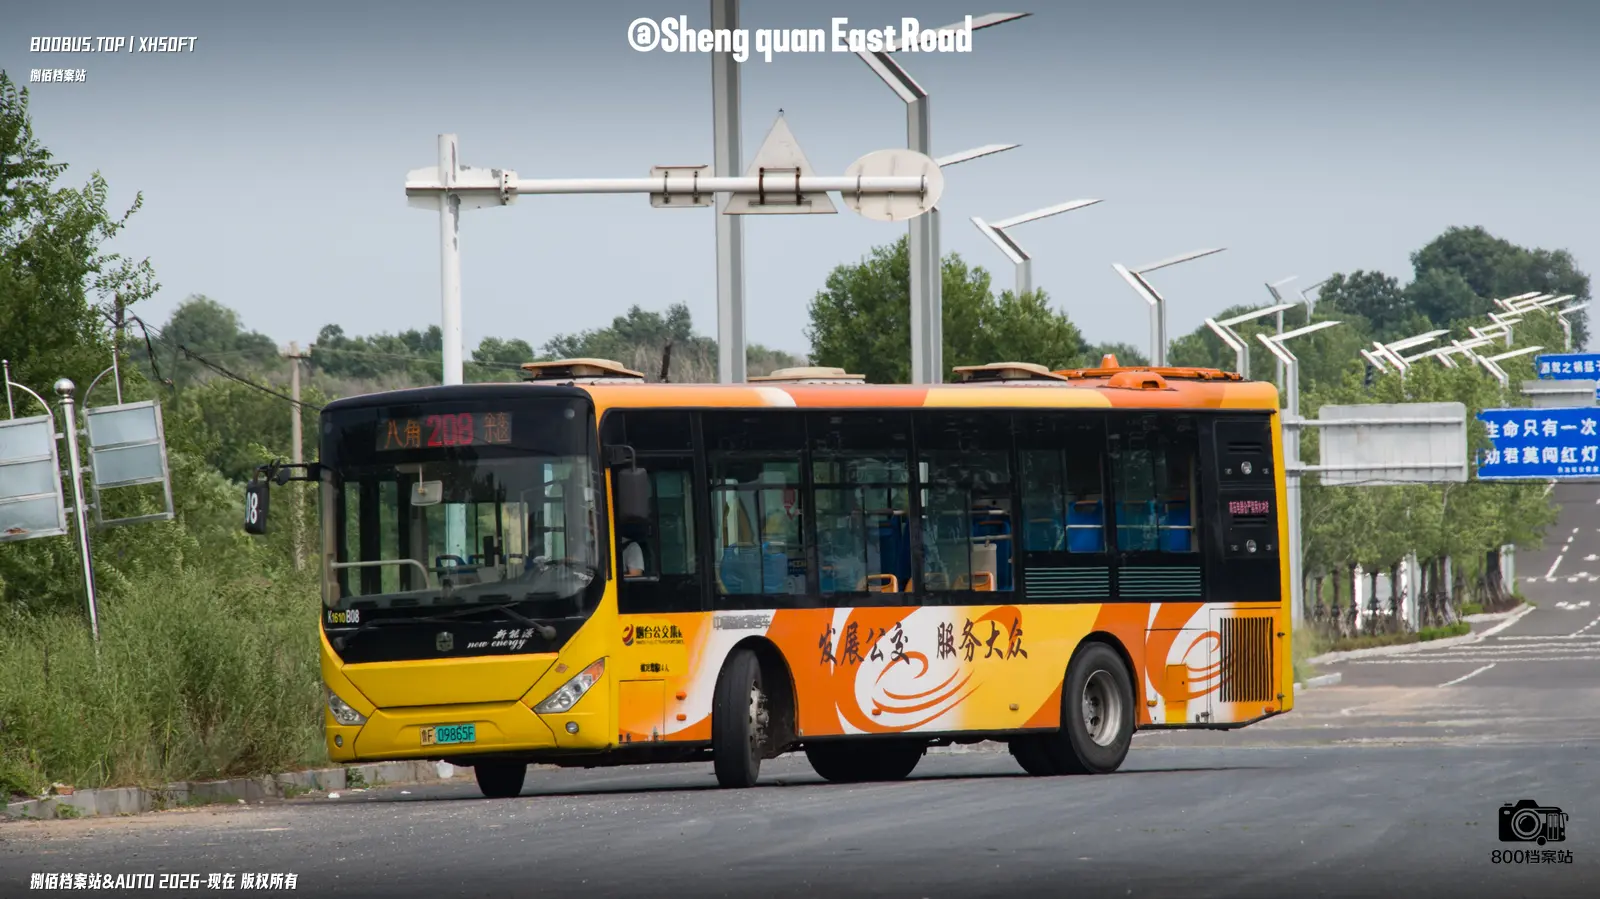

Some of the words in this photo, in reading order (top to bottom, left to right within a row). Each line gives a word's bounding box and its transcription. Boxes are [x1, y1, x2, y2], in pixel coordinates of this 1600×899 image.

[384, 418, 421, 449] 八角
[1485, 418, 1597, 438] 生命只有一次
[1484, 446, 1599, 465] 劝君莫闯红灯
[467, 640, 489, 649] new
[491, 637, 527, 650] energy
[818, 620, 911, 666] 发展公交
[936, 617, 1028, 663] 服务大众
